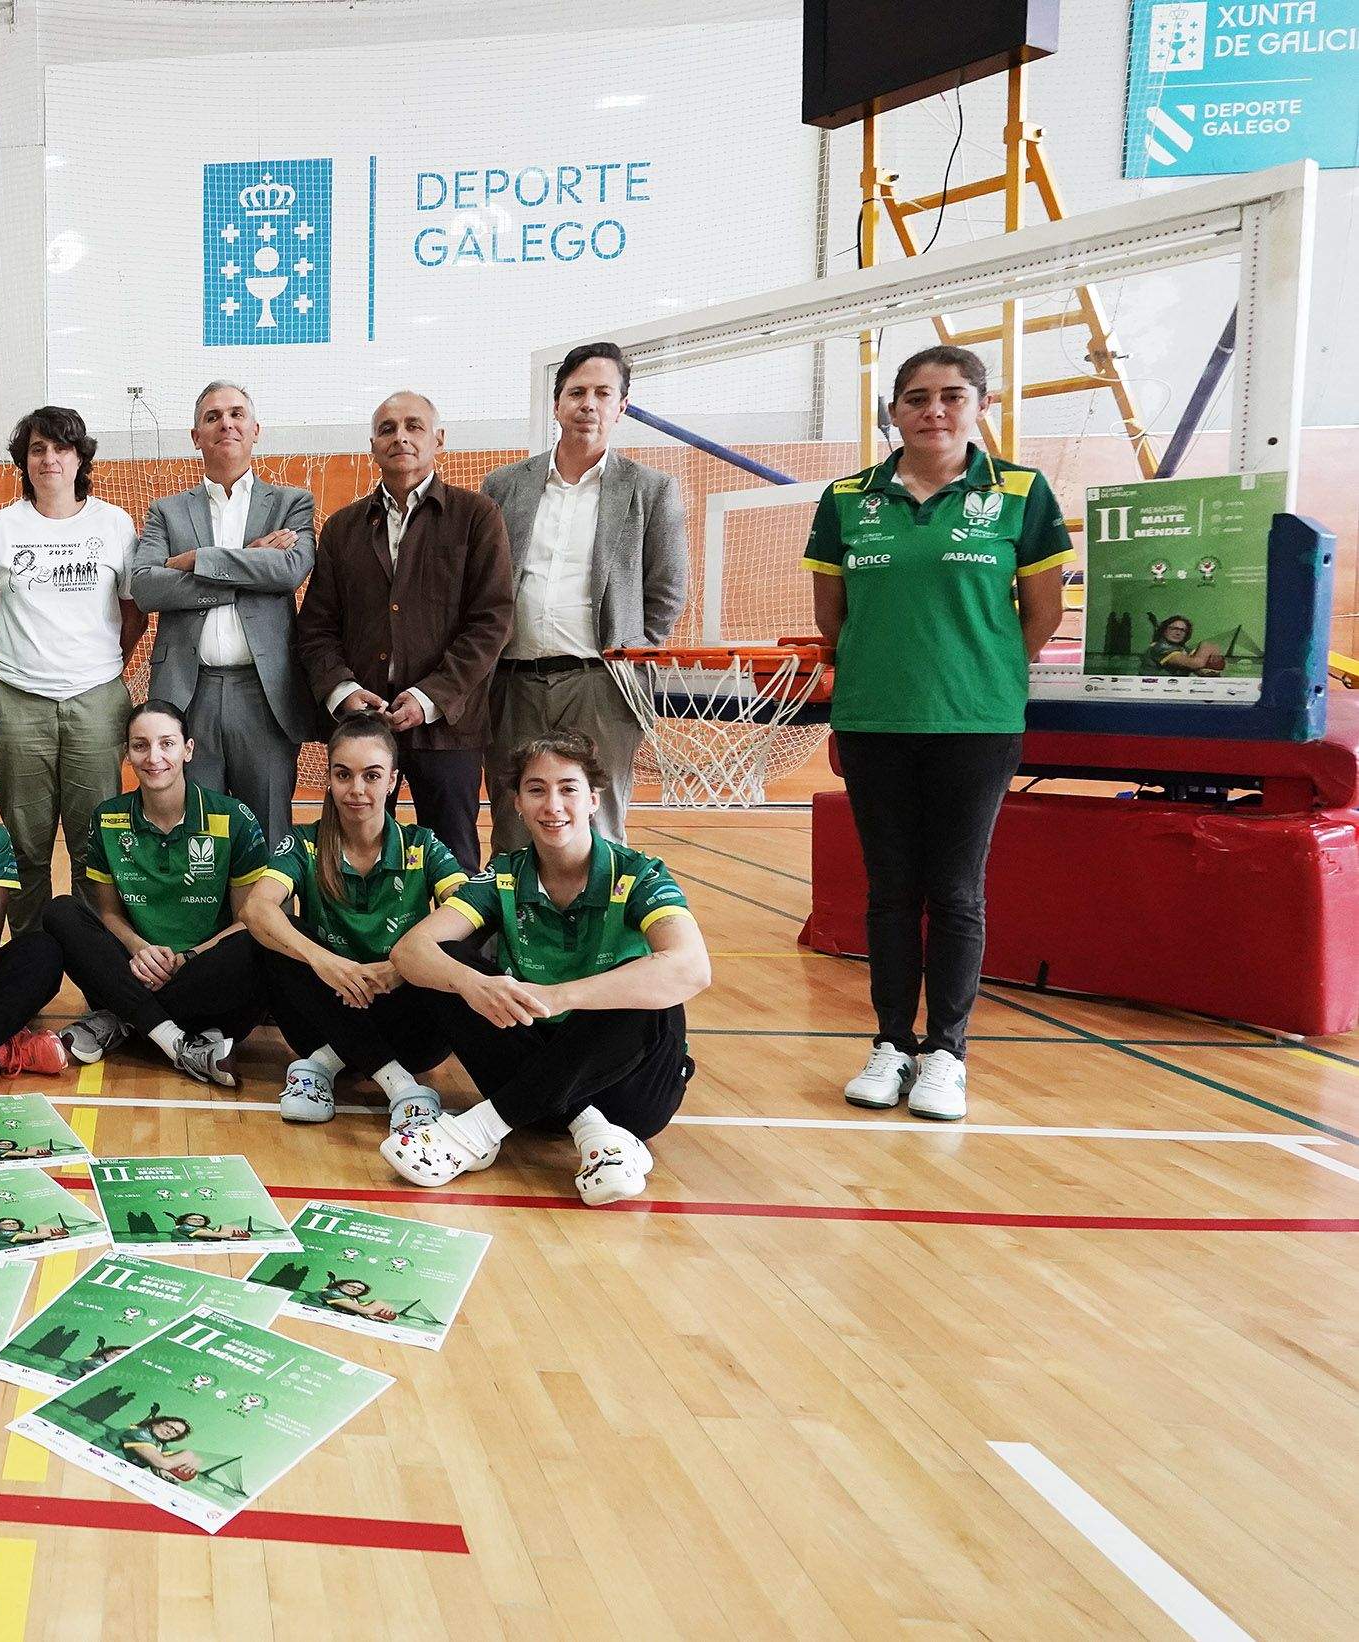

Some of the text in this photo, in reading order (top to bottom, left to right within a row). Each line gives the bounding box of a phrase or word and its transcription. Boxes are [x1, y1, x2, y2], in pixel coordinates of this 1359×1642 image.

[1216, 1, 1317, 29] XUNTA
[1214, 28, 1359, 57] DE GALICI
[1204, 100, 1302, 118] DEPORTE
[1202, 118, 1291, 136] GALEGO
[416, 161, 652, 212] DEPORTE
[414, 218, 627, 267] GALEGO
[969, 518, 990, 528] LF2
[1141, 514, 1185, 525] MAITE
[1134, 526, 1192, 538] MÉNDEZ
[857, 553, 891, 566] ence
[123, 893, 147, 903] ence
[87, 1264, 139, 1291] II
[166, 1322, 228, 1354] II
